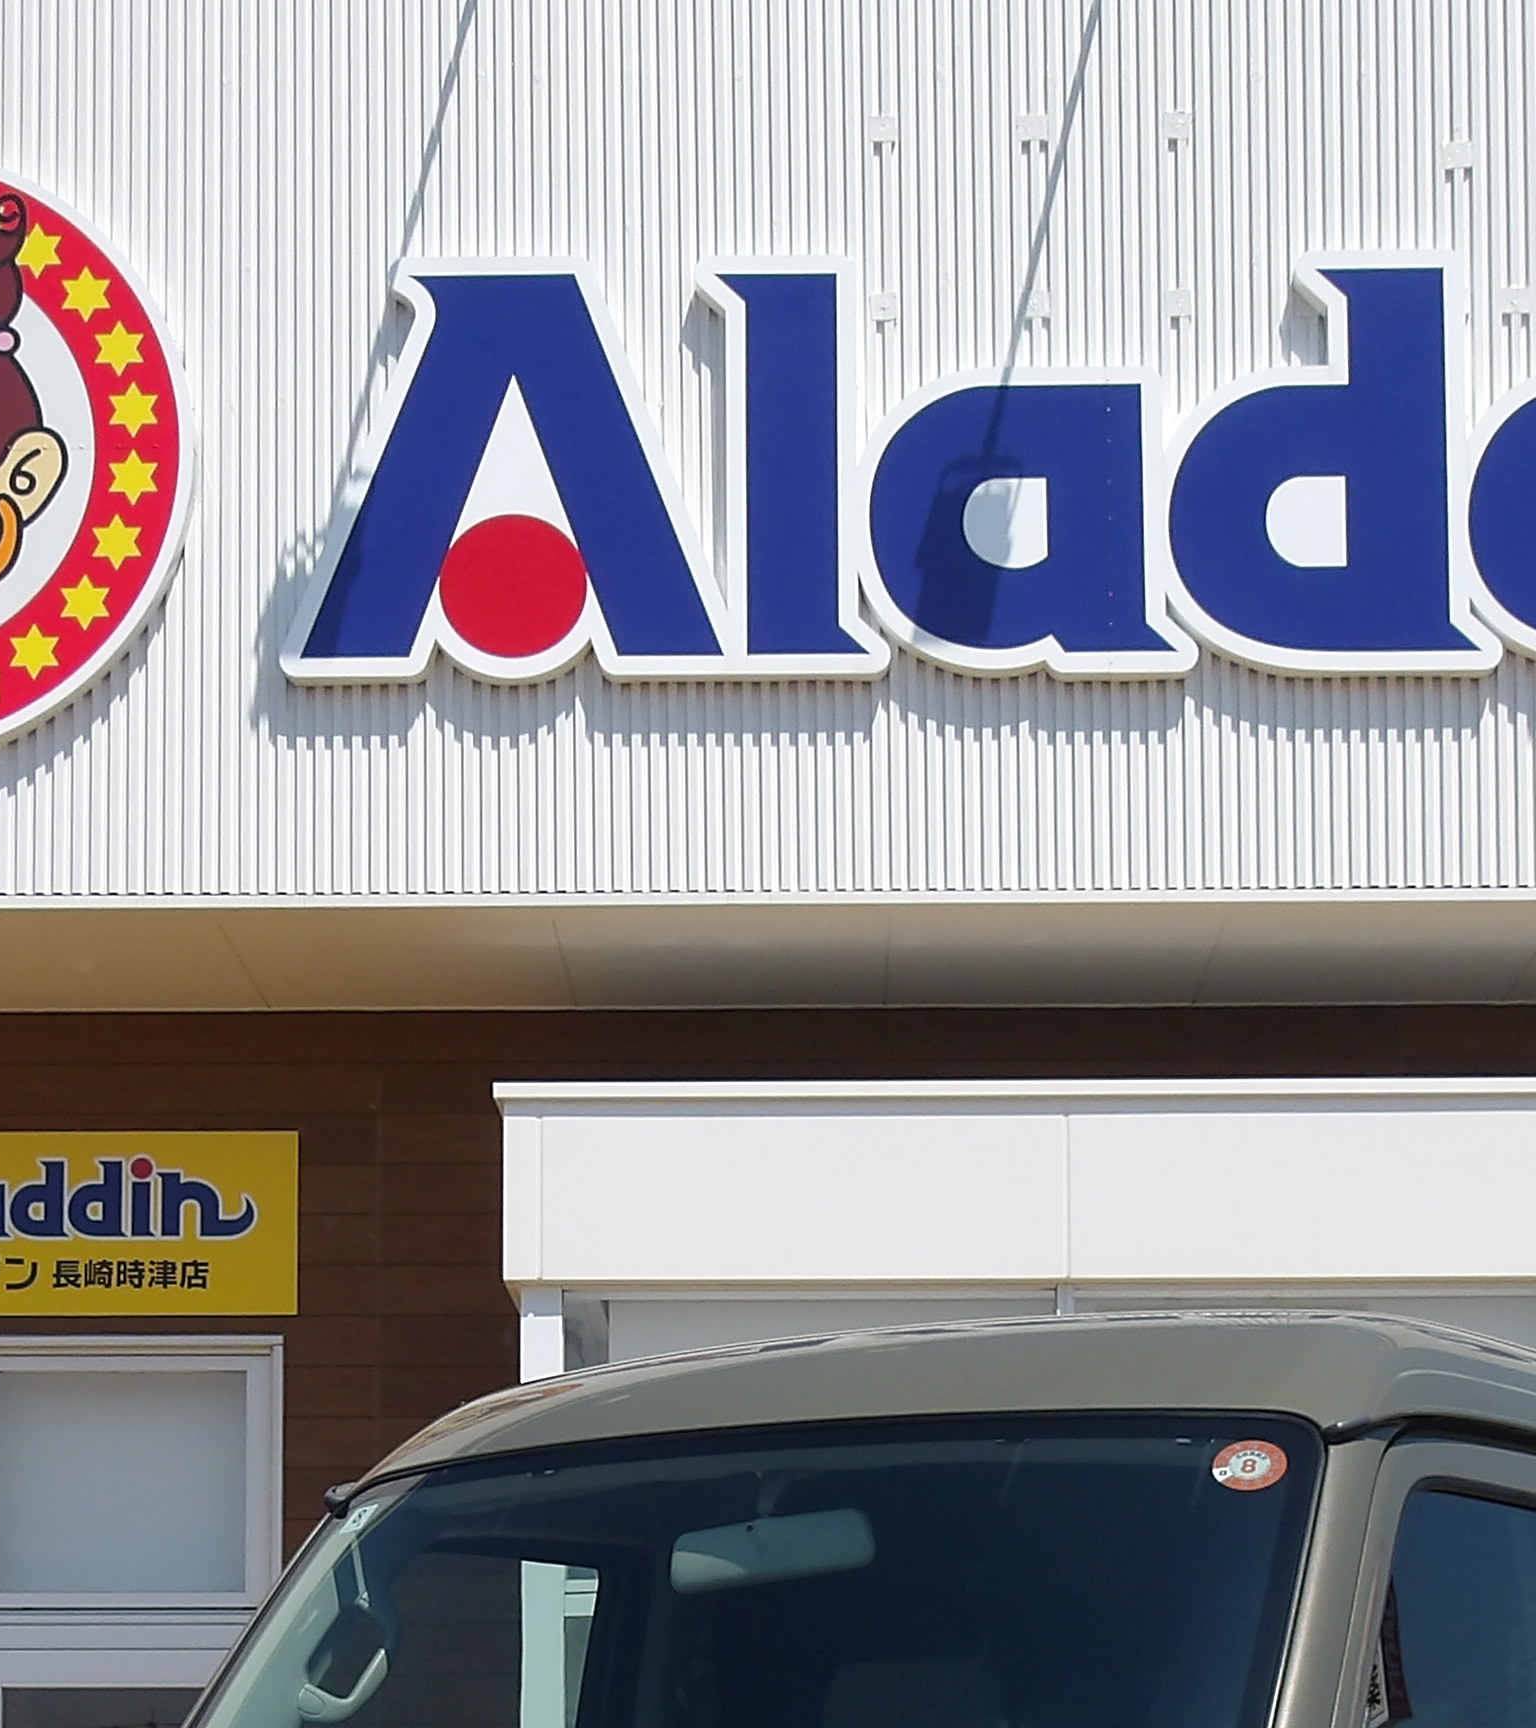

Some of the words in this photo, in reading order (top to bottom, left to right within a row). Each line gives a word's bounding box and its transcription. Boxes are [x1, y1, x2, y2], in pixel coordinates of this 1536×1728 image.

[52, 1258, 210, 1290] 長崎時津店
[1240, 1459, 1257, 1473] 8
